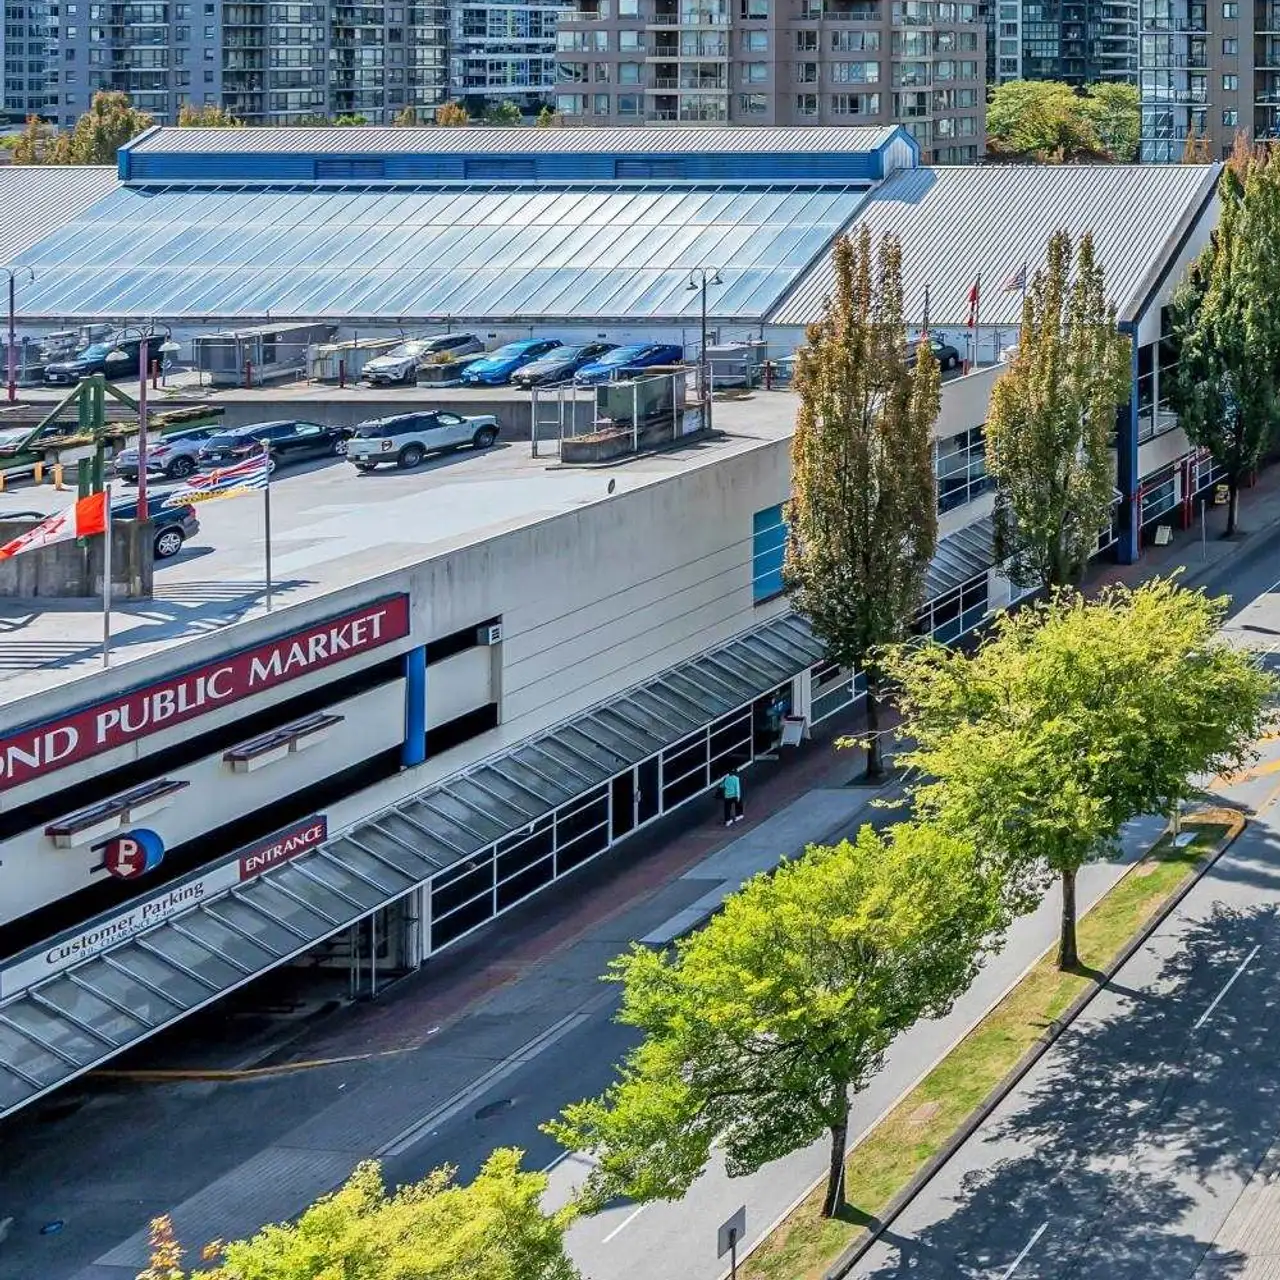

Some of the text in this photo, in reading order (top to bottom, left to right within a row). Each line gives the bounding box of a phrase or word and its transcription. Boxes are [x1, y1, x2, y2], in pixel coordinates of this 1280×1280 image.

[0, 610, 387, 778] ND PUBLIC MARKET
[119, 839, 138, 864] P
[245, 824, 324, 873] ENTRANCE
[46, 881, 205, 965] Customer Parking
